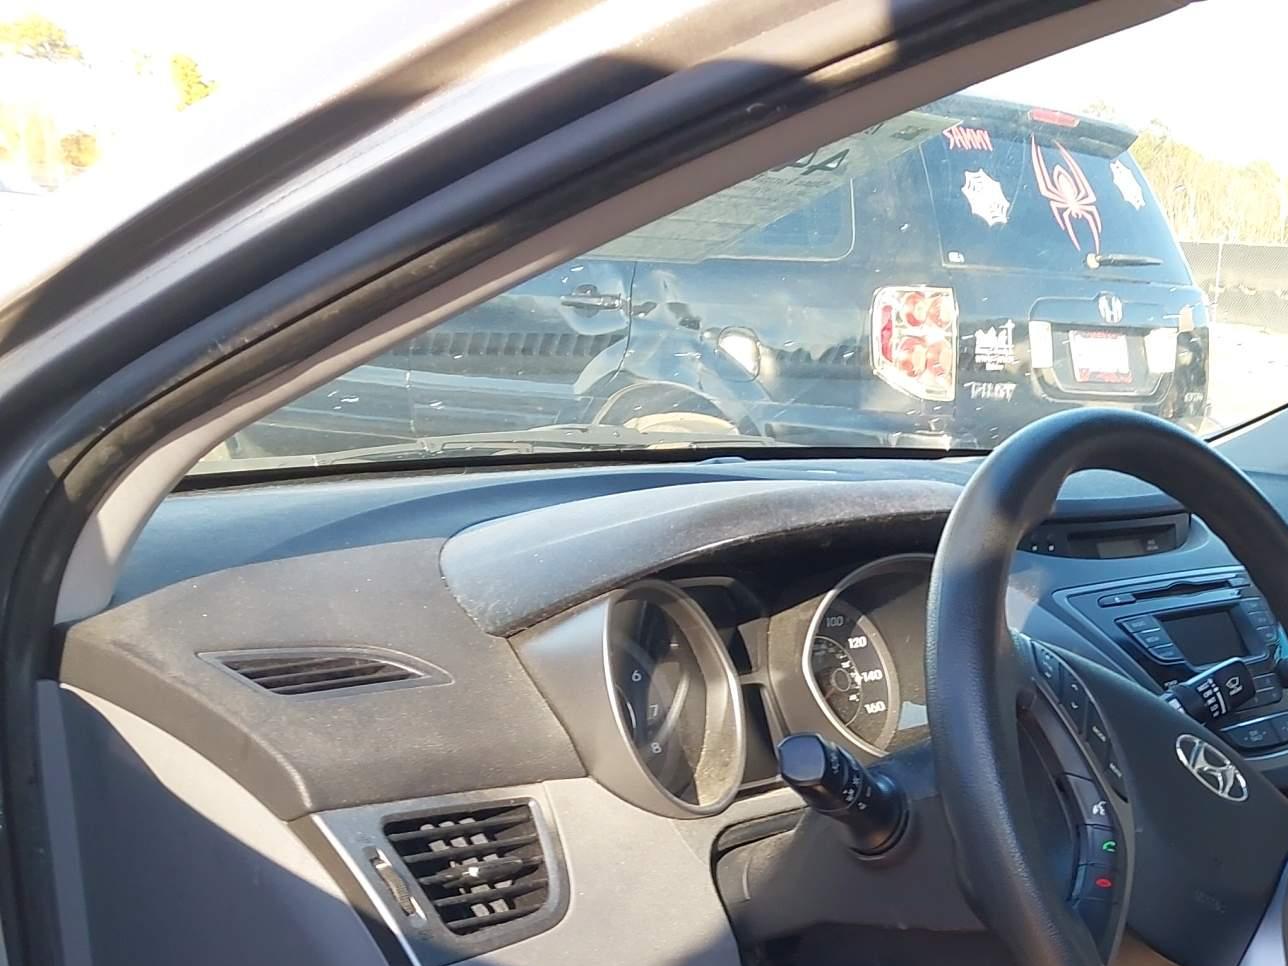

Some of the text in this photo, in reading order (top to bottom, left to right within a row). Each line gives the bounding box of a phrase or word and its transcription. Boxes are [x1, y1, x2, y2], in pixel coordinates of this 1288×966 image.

[825, 616, 844, 628] 100
[847, 636, 868, 649] 120
[631, 670, 642, 682] 6
[861, 669, 884, 683] 140
[648, 704, 659, 717] 7
[864, 700, 887, 715] 160
[650, 742, 662, 754] 8
